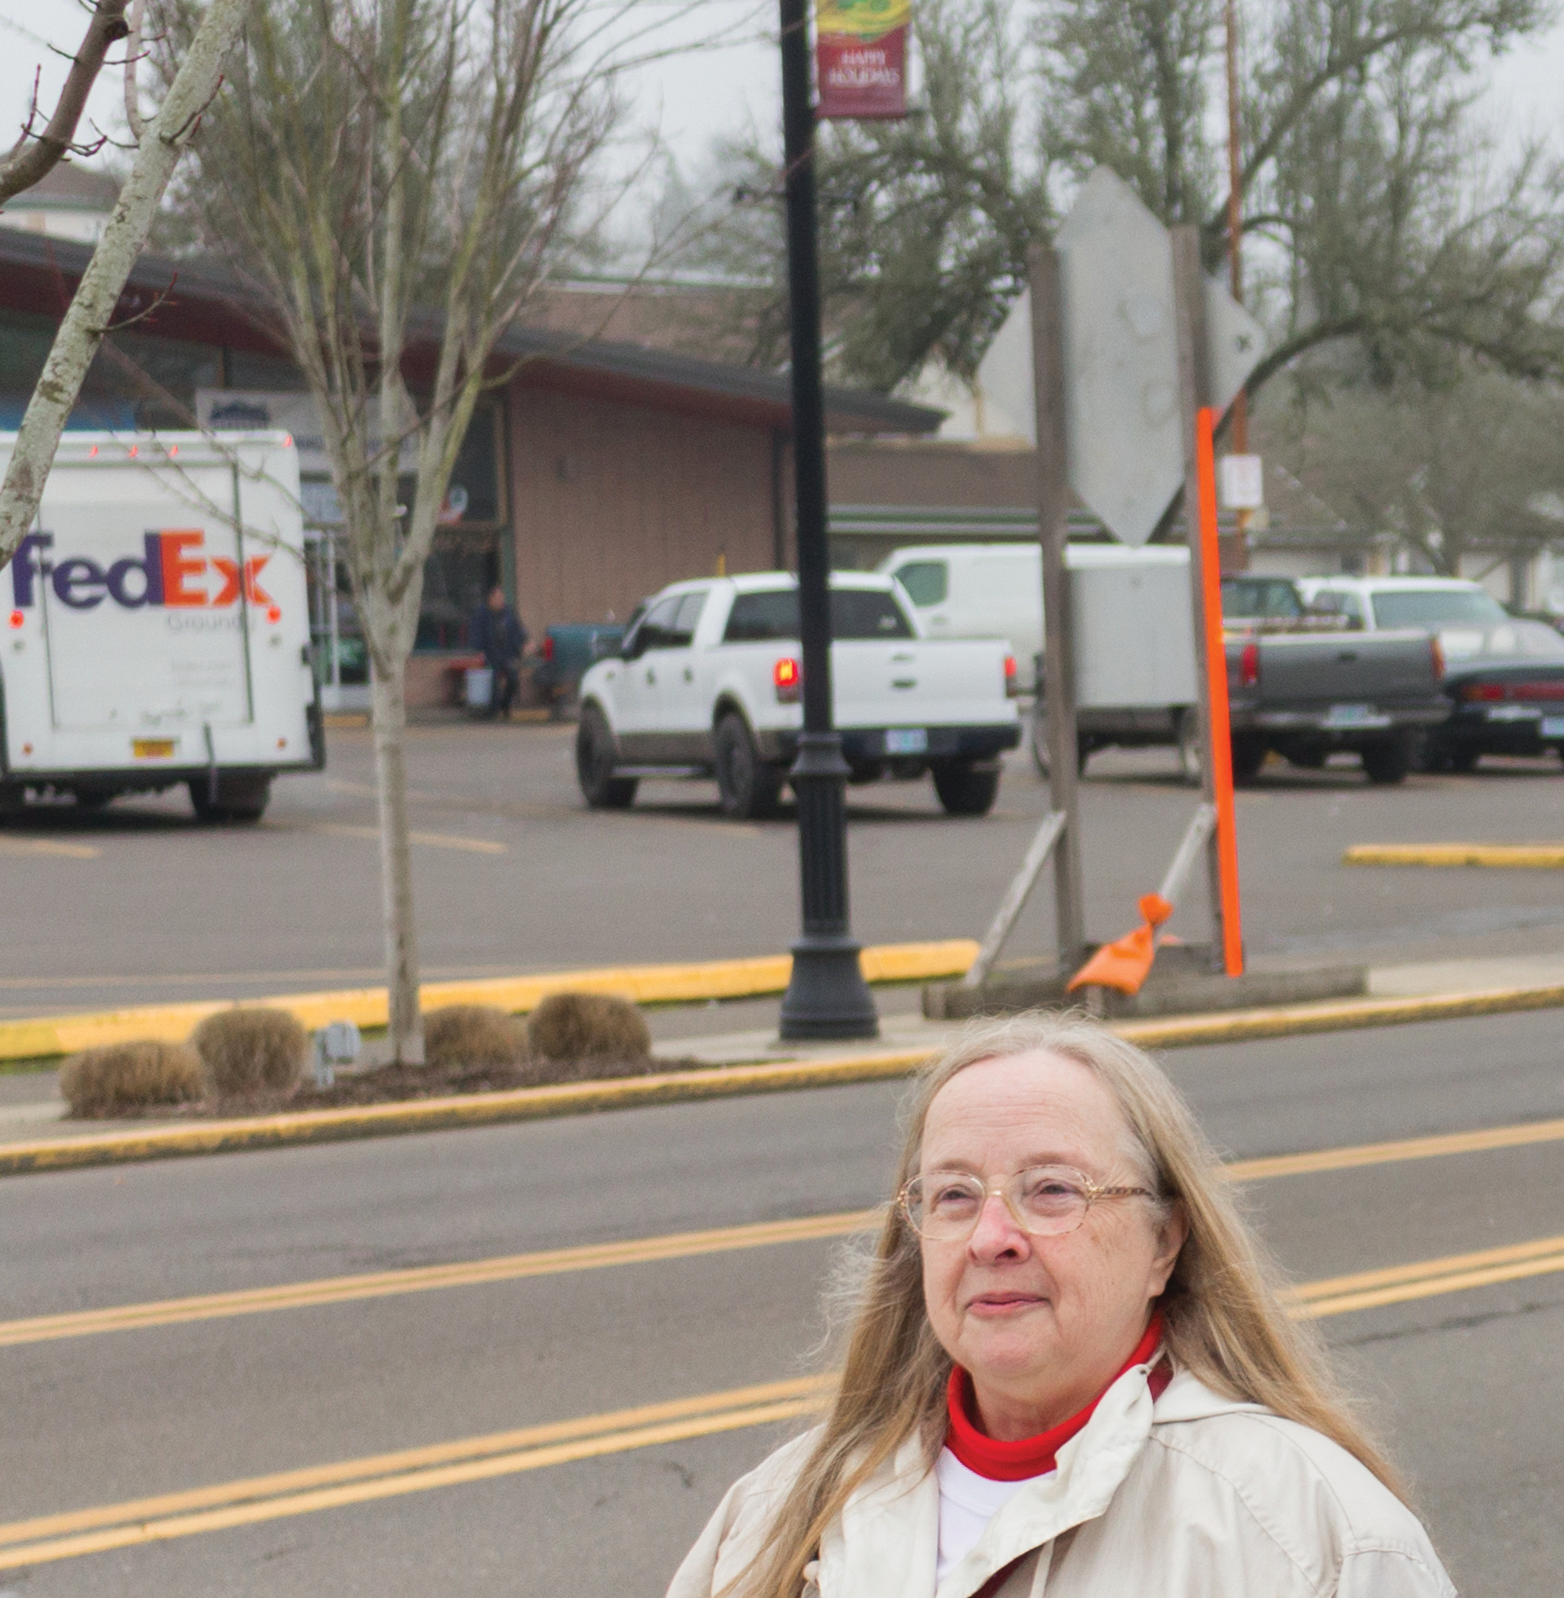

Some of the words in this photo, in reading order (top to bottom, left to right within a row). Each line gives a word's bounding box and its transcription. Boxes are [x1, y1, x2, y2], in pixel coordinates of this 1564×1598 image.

[841, 50, 885, 65] HAPPY
[828, 68, 900, 86] HOLIDAYS
[12, 527, 274, 609] FedEx
